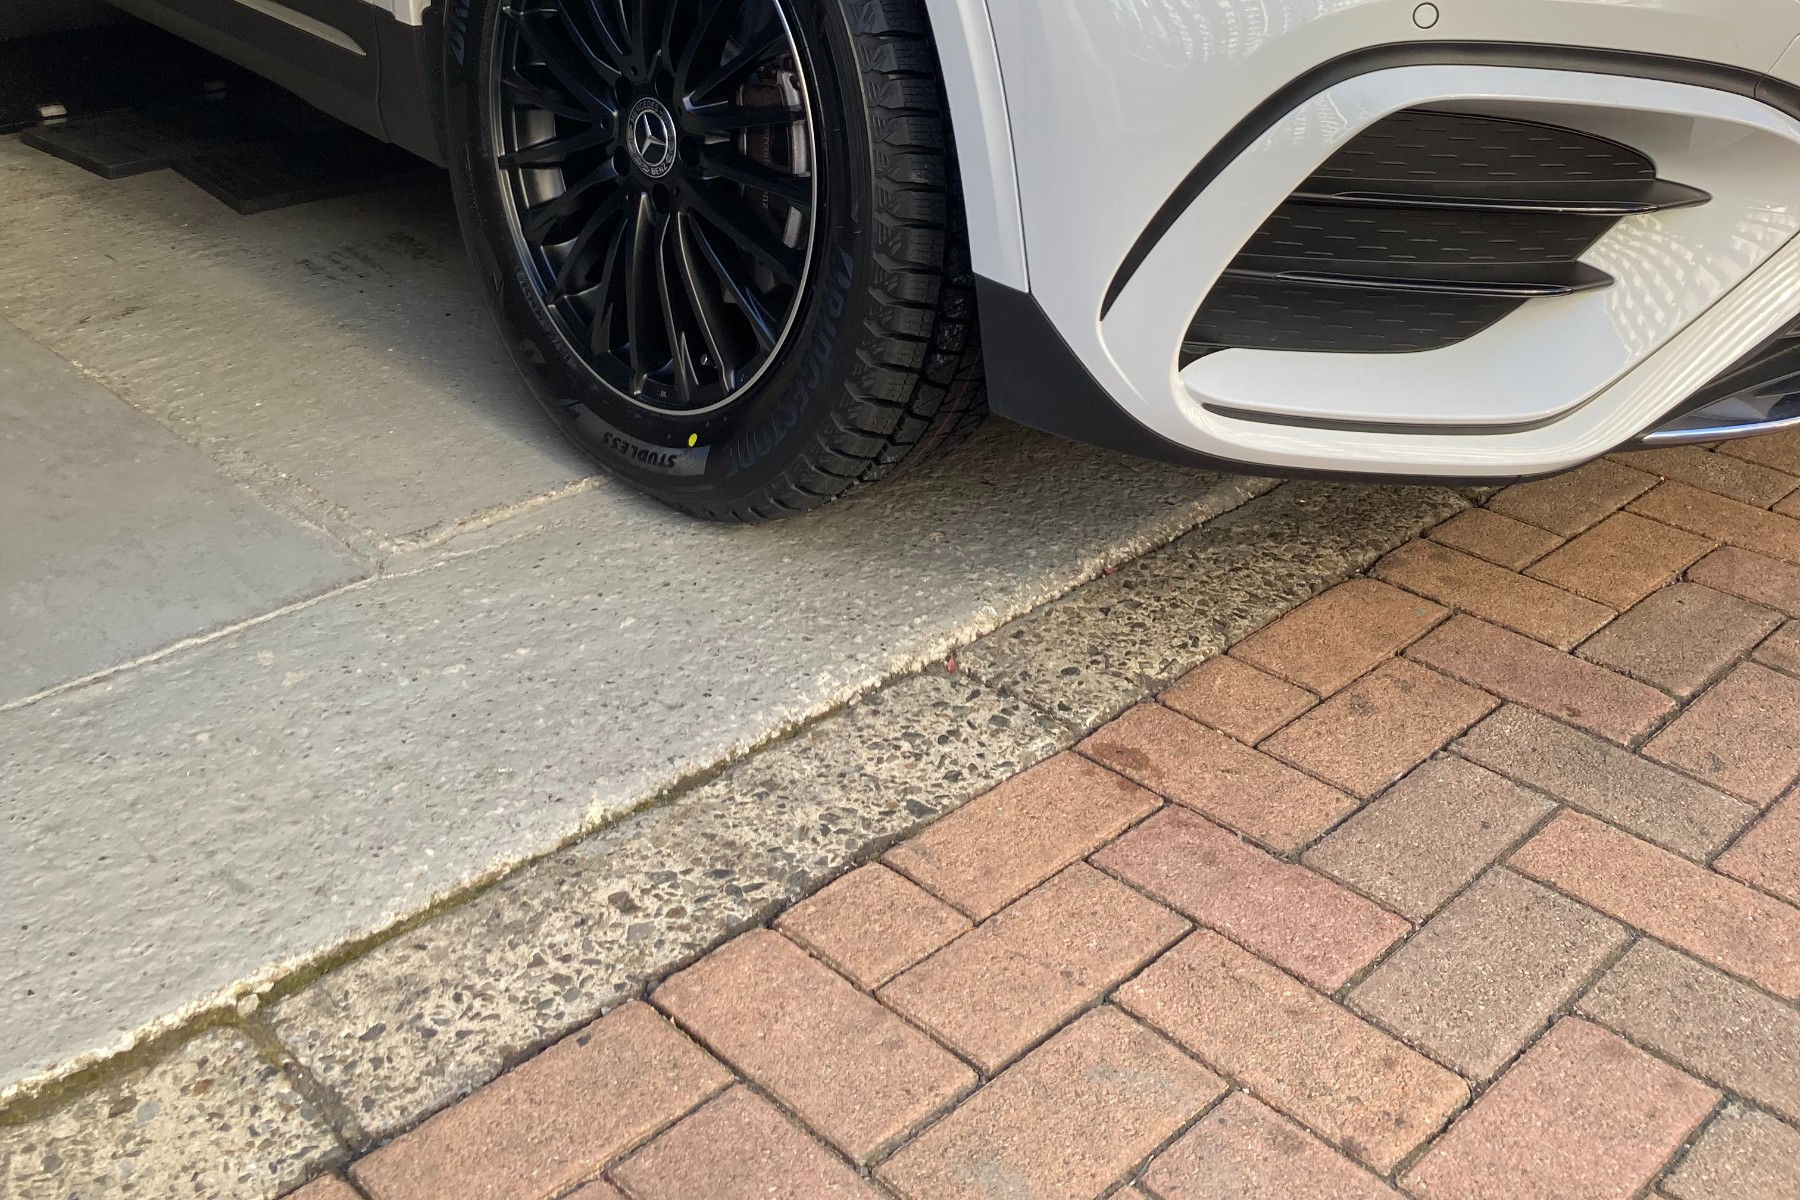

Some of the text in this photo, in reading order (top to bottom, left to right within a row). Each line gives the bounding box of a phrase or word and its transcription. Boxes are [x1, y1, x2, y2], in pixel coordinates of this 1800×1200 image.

[630, 101, 660, 125] MERCEDES
[650, 163, 669, 176] BENZ
[601, 431, 677, 468] STUDLESS
